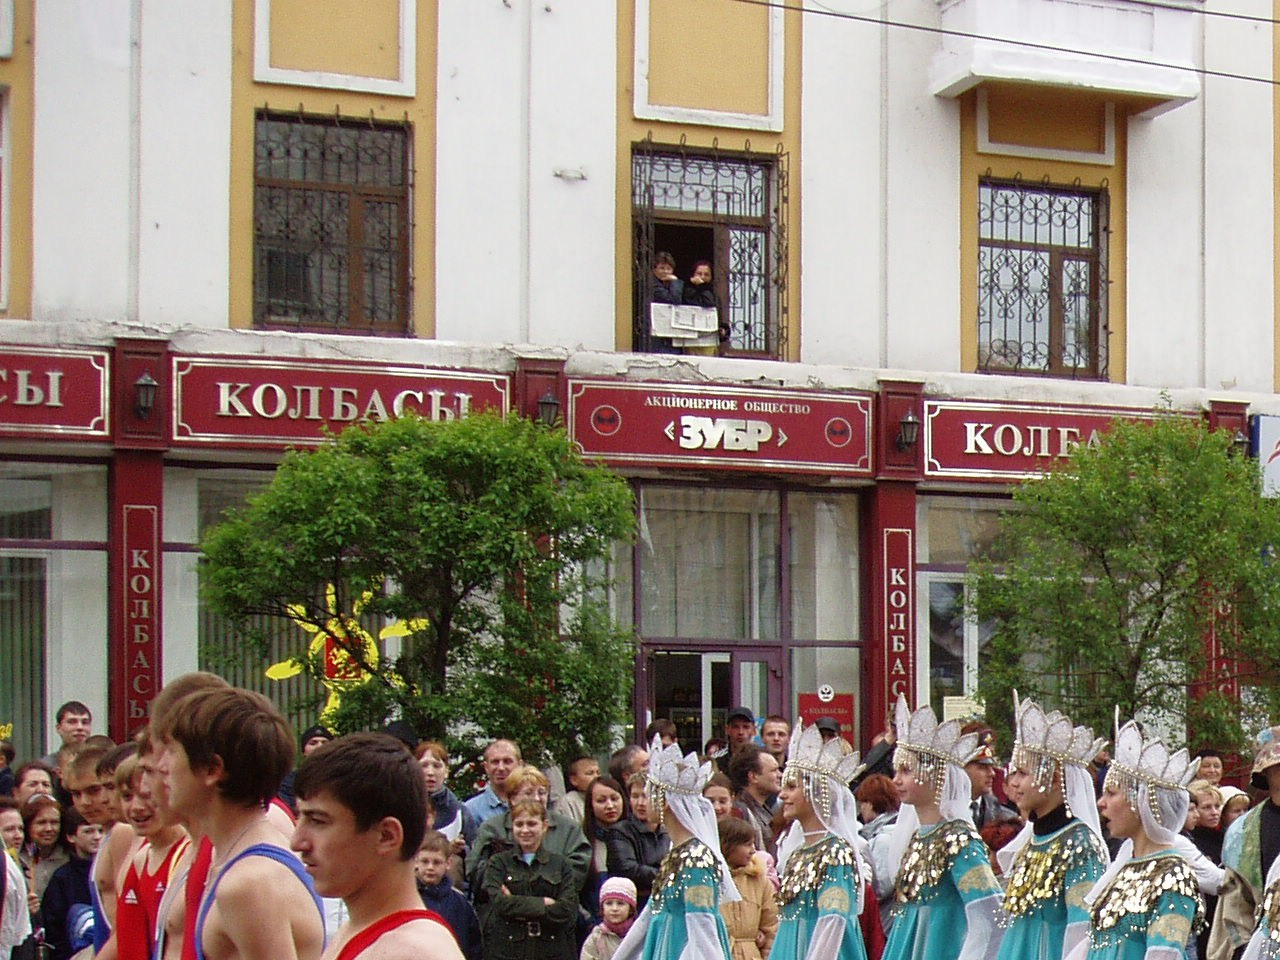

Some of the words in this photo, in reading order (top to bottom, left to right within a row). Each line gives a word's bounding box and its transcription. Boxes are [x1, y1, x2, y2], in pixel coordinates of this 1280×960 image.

[215, 382, 474, 423] КОЛБАСЫ
[744, 401, 811, 414] ОБЩЕСТВО
[964, 422, 1101, 457] КОЛБА
[129, 550, 151, 718] КОЛБАСЫ
[889, 568, 907, 713] КОЛБАС
